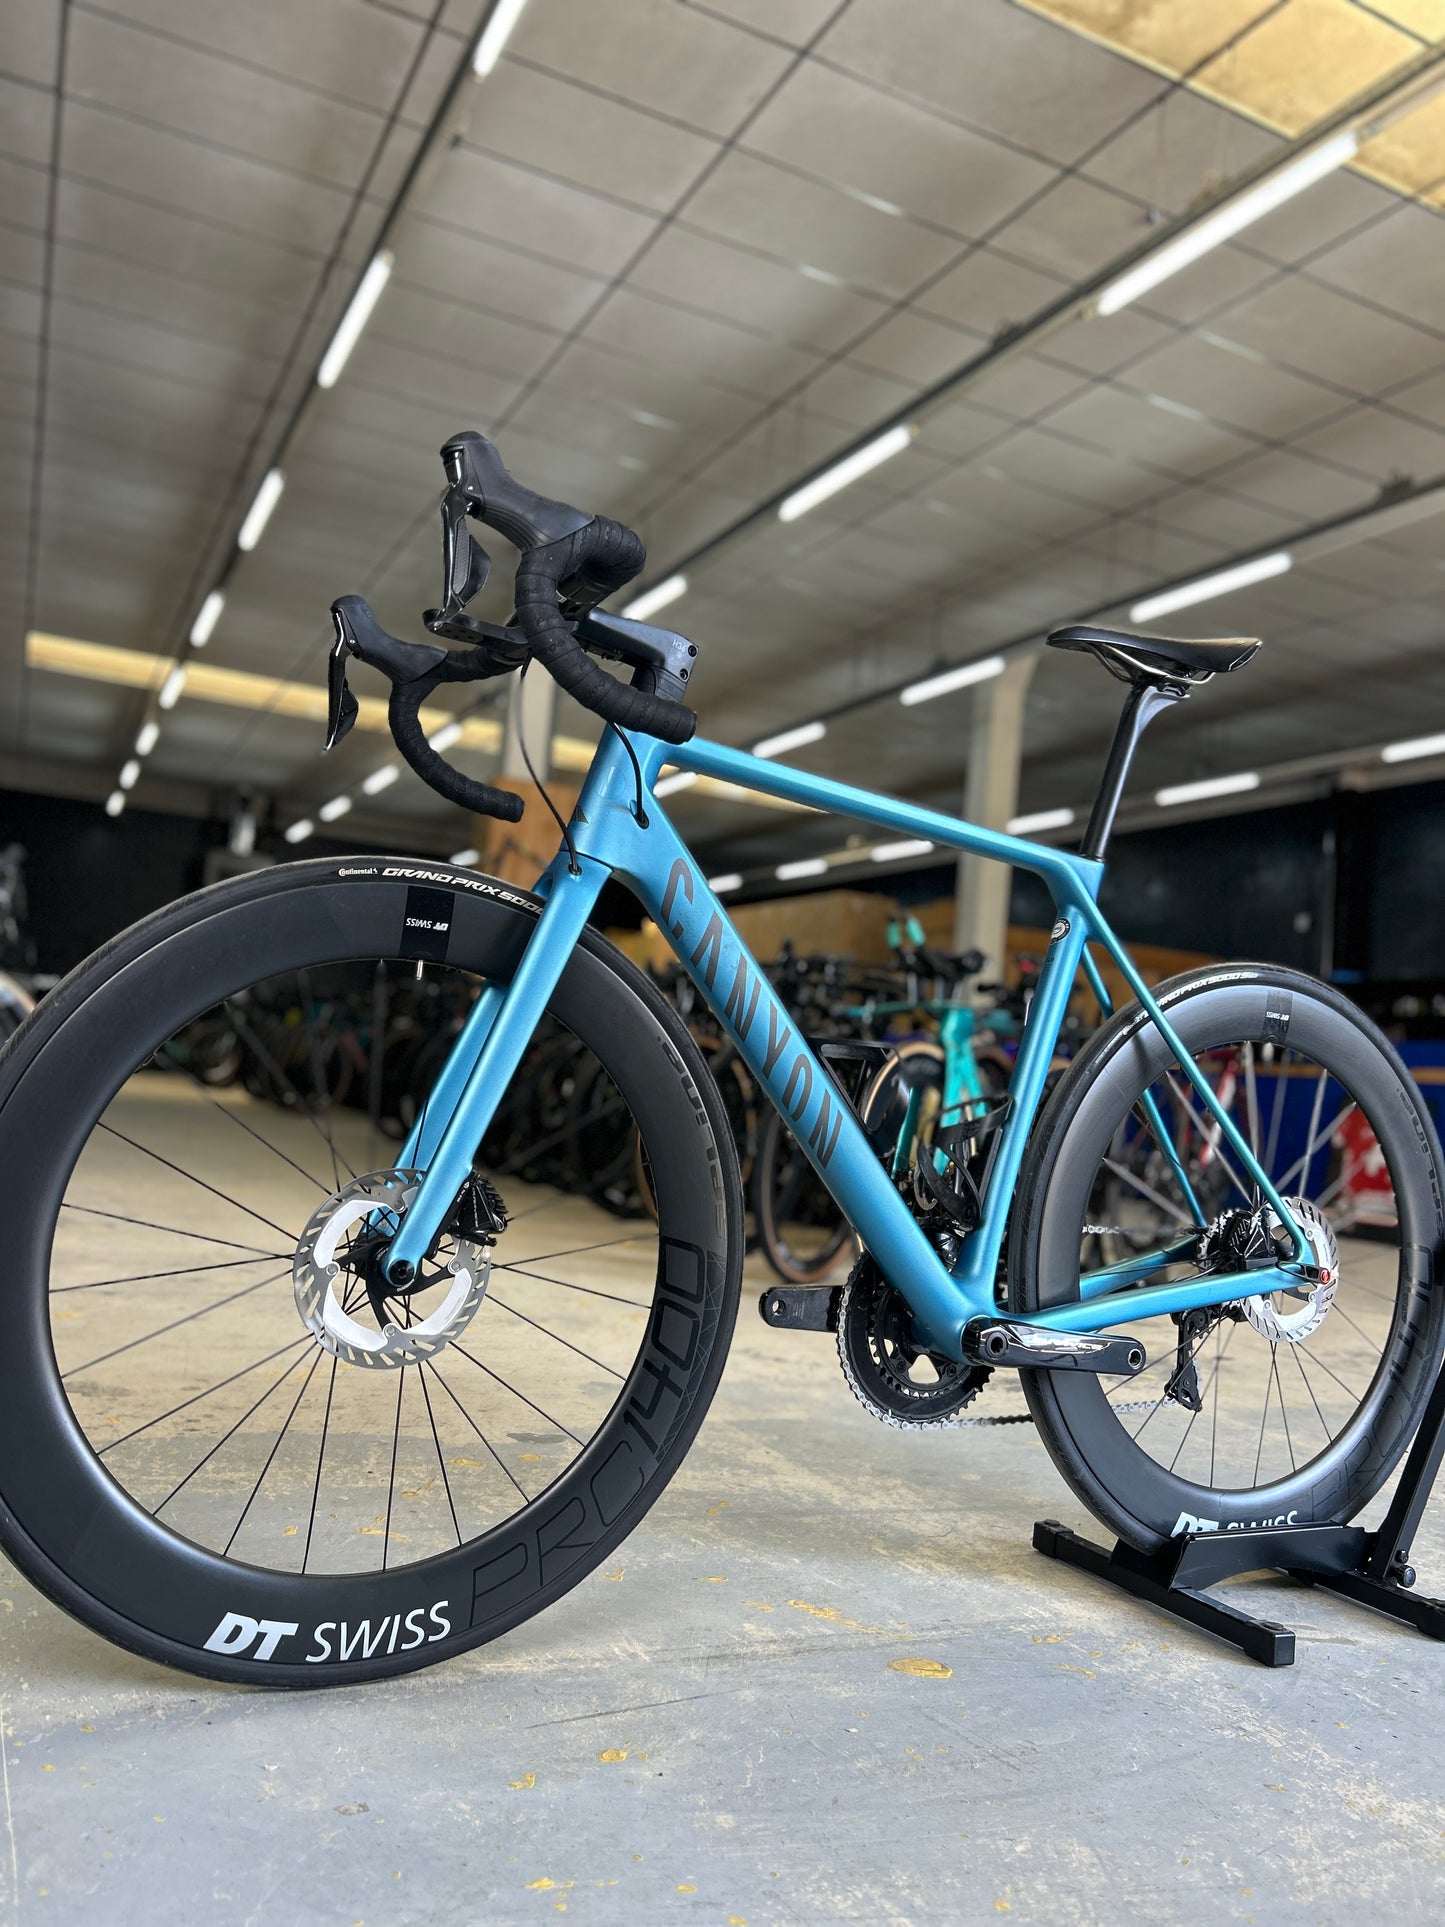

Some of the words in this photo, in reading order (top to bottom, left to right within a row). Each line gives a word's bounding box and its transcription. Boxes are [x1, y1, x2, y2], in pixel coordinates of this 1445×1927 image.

[672, 639, 687, 652] H36
[338, 867, 373, 877] Continental
[382, 867, 452, 885] GRAND
[450, 877, 502, 896] PRIX
[406, 917, 431, 929] SWISS
[433, 922, 449, 932] DT
[660, 858, 843, 1168] CANYON
[468, 1440, 645, 1628] PRC
[622, 1236, 706, 1455] 1400
[202, 1611, 298, 1661] DT
[304, 1600, 451, 1663] SWISS
